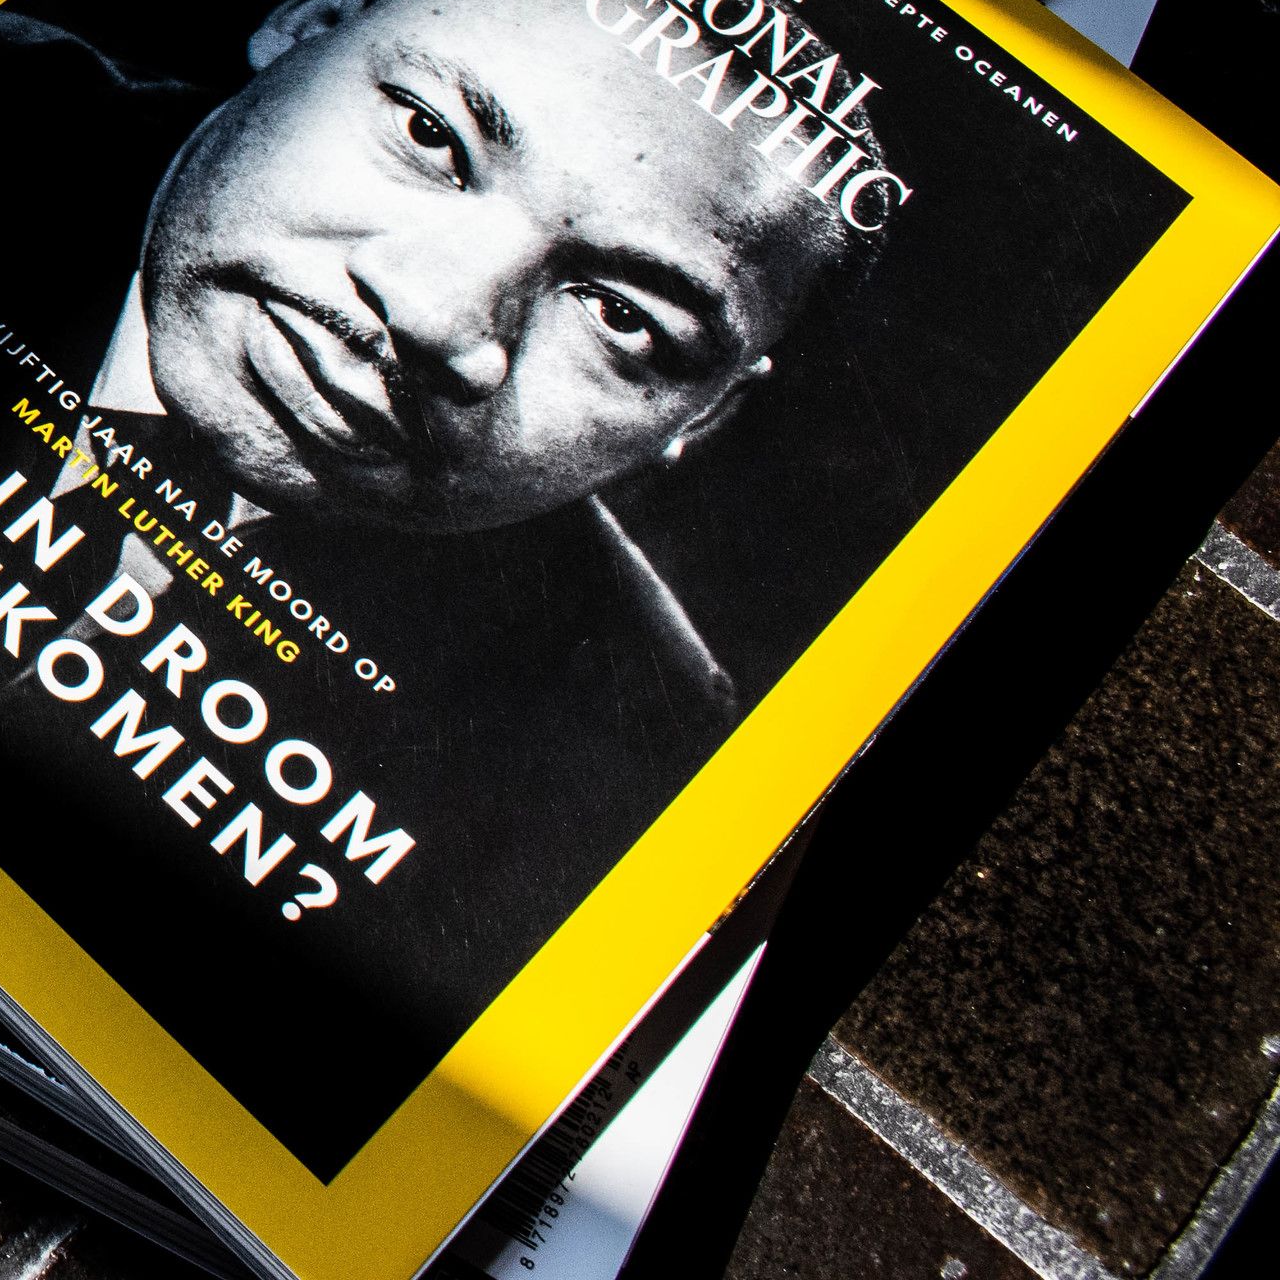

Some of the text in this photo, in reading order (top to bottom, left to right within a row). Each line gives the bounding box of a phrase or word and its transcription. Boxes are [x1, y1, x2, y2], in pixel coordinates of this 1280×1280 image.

[954, 44, 1080, 145] OCEANEN
[10, 397, 301, 666] MARTIN LUTHER KING
[80, 411, 154, 480] JAAR
[157, 479, 197, 523] NA
[202, 517, 244, 559] DE
[243, 557, 352, 653] MOORD
[353, 656, 398, 695] OP
[85, 572, 417, 886] DROOM
